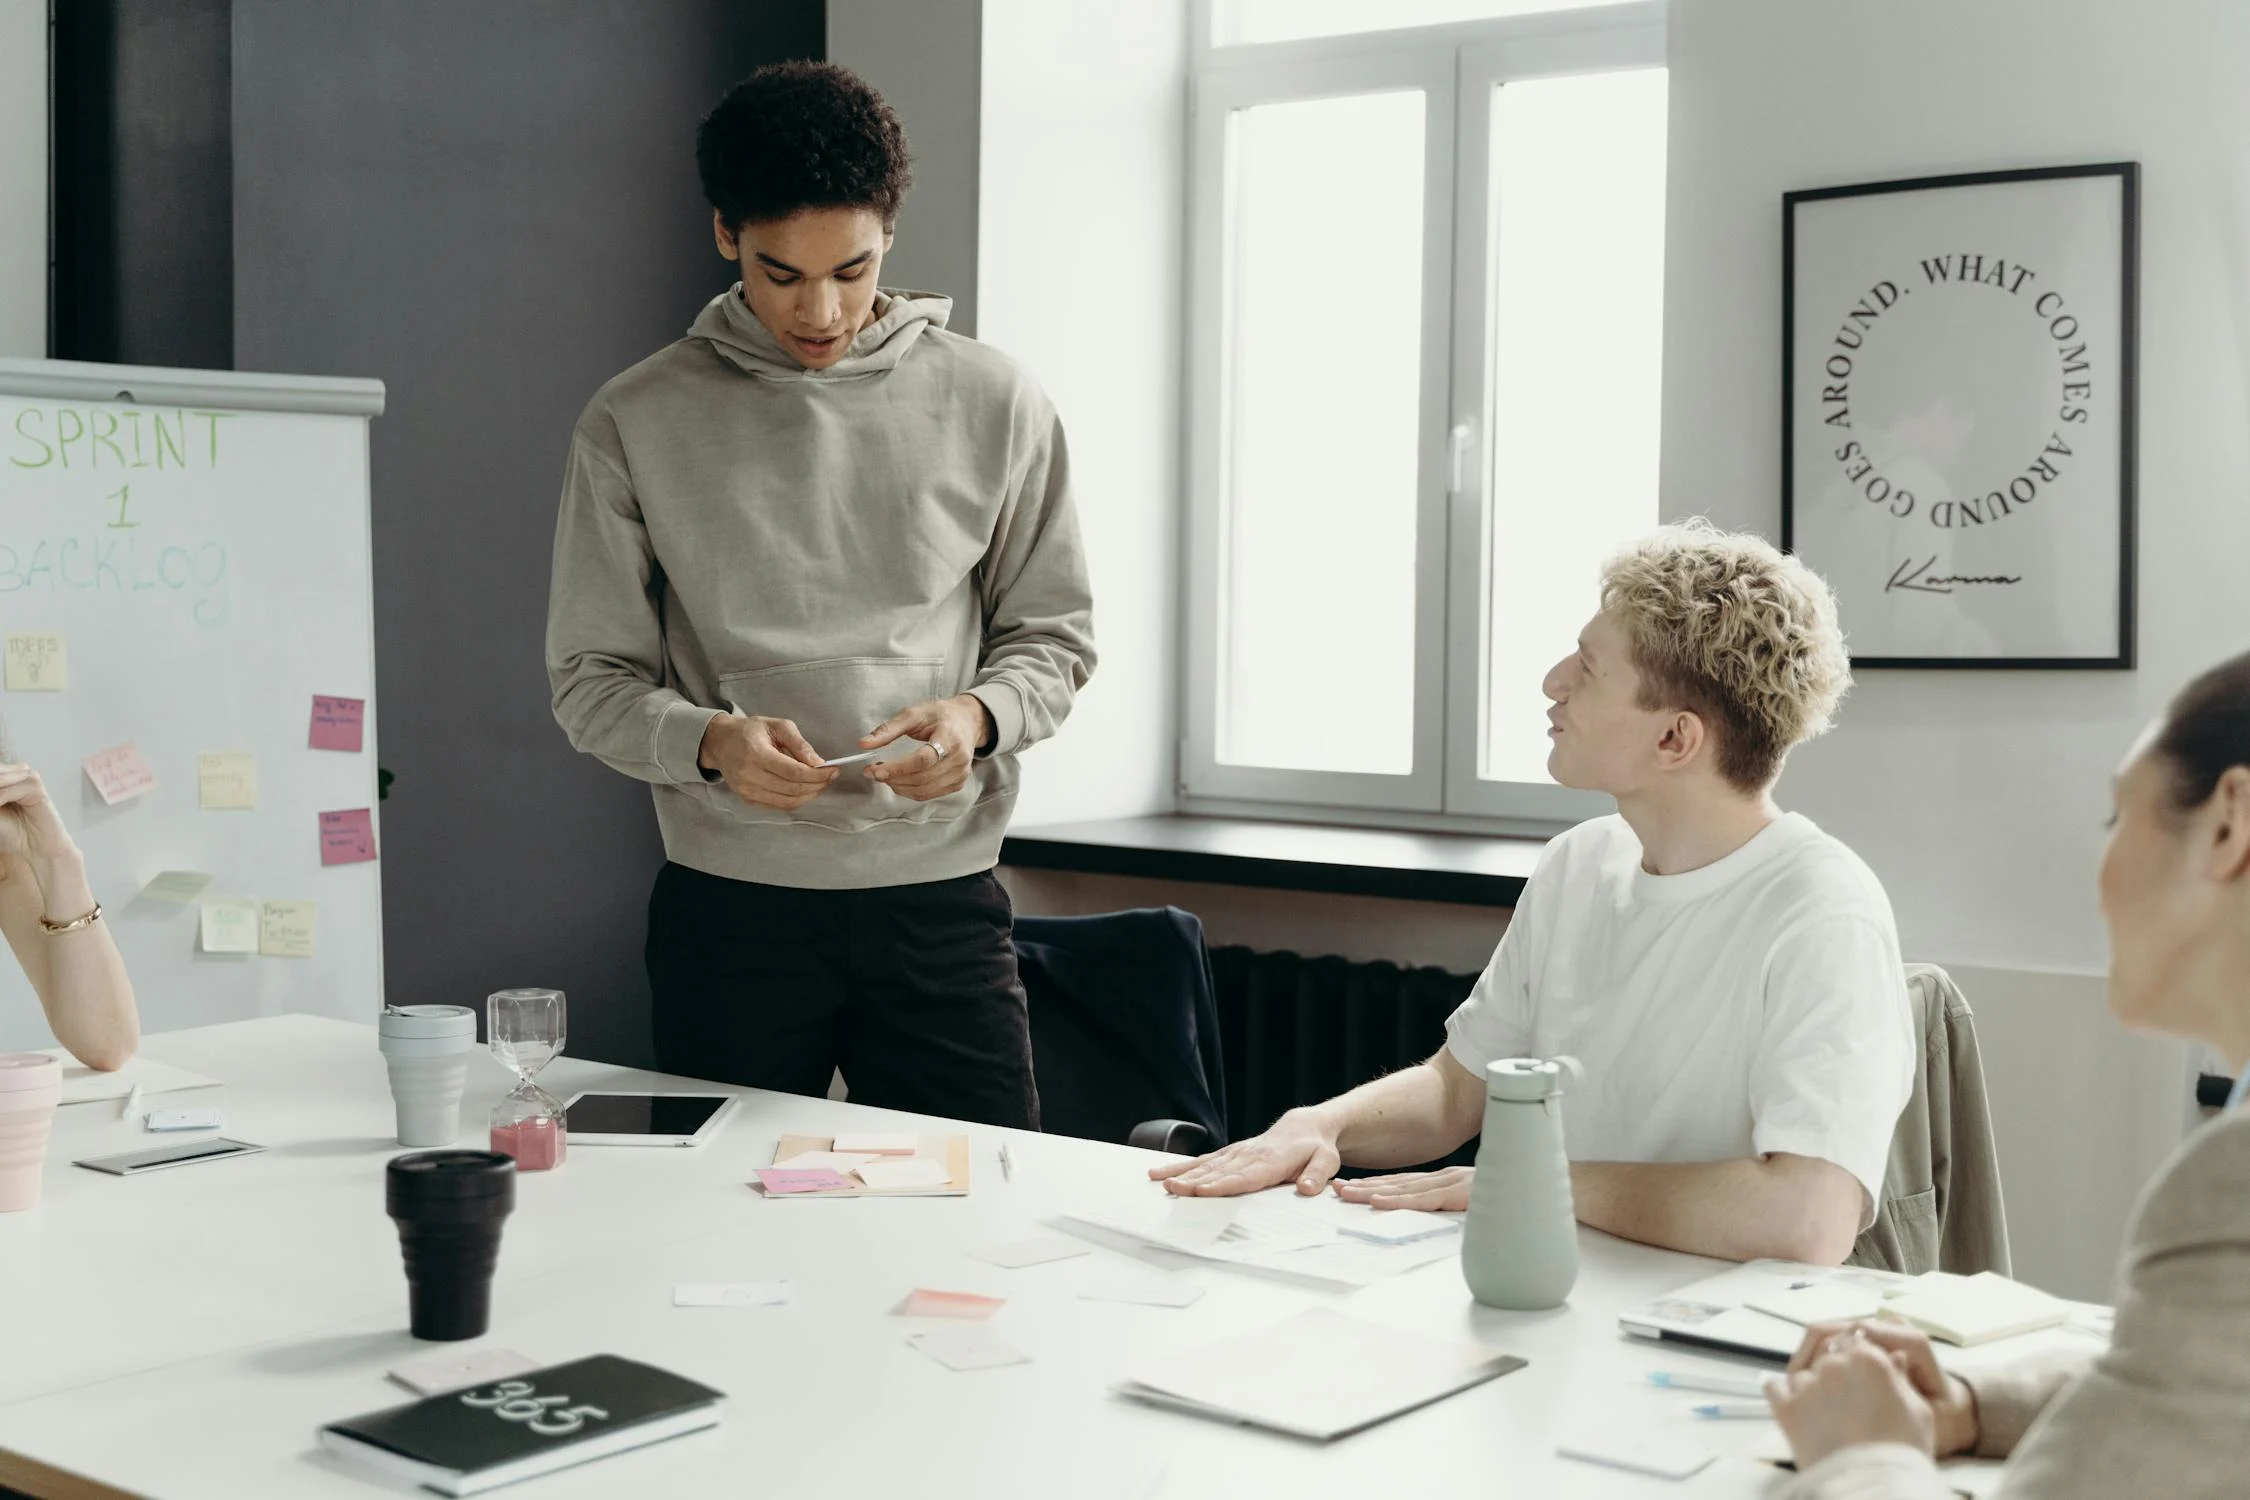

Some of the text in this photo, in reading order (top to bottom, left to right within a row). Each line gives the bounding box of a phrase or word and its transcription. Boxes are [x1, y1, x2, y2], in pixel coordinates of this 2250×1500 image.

[1821, 253, 2091, 529] WHAT COMES AROUND GOES AROUND.
[9, 407, 239, 472] SPRINT
[105, 484, 141, 529] 1
[459, 1380, 610, 1437] 365
